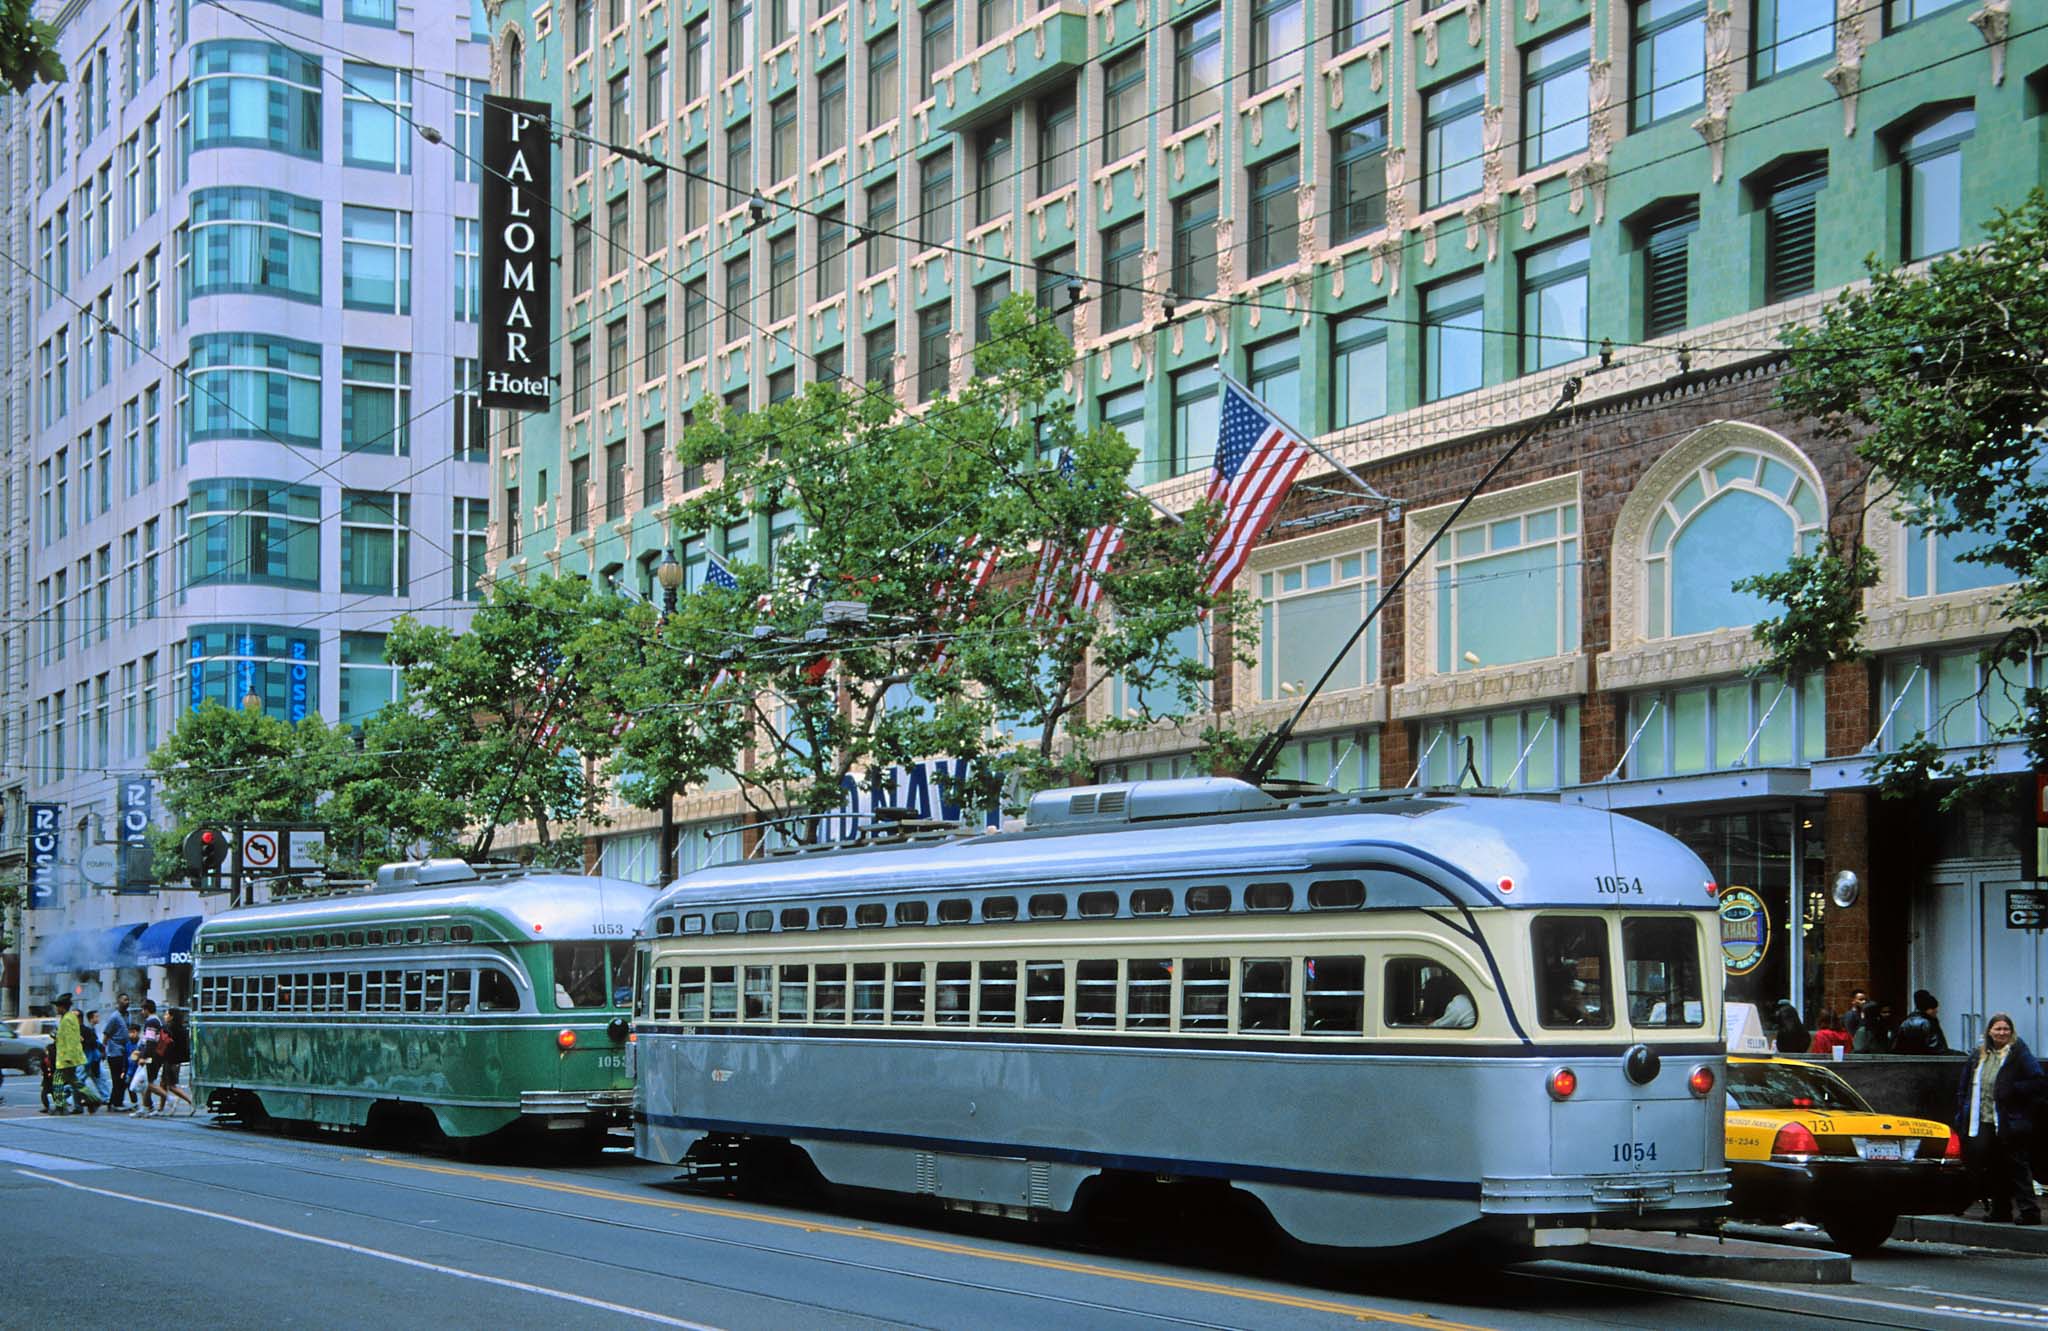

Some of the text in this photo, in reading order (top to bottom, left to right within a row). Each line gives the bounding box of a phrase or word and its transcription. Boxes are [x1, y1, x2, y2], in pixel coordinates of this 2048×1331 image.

[503, 112, 535, 363] PALOMAR
[487, 371, 550, 396] Hotel
[293, 642, 307, 721] ROSS
[35, 809, 55, 897] ROSS
[1594, 876, 1643, 894] 1054
[592, 924, 624, 935] 1053
[1808, 1119, 1836, 1133] 731
[1612, 1142, 1657, 1161] 1054
